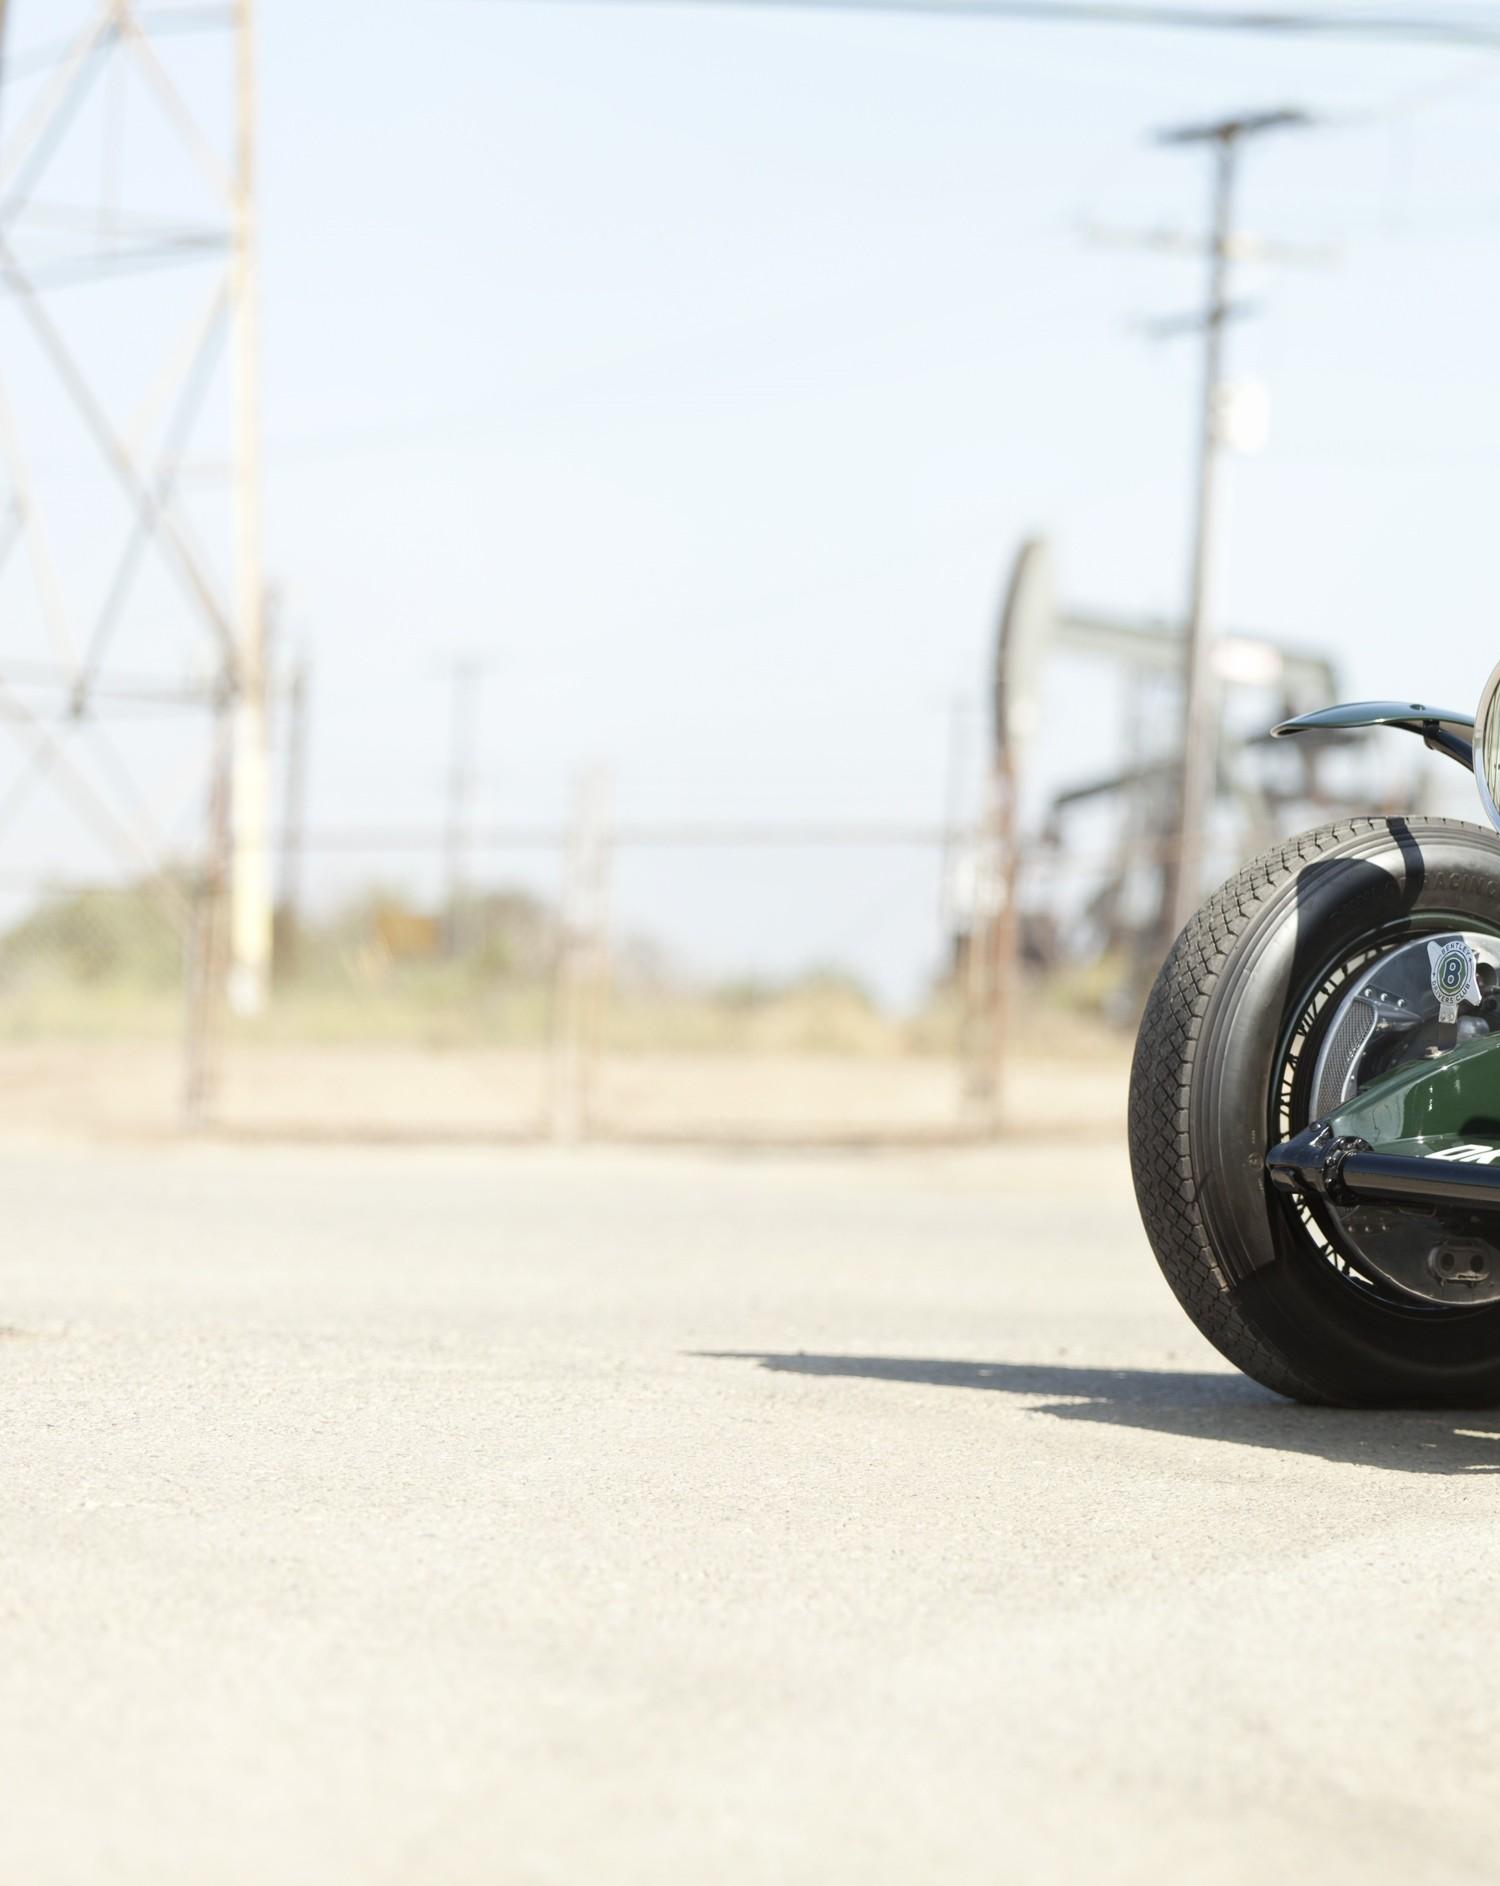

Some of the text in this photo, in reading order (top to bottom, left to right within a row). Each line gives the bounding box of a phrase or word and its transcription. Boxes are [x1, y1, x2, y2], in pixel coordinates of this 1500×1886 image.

[1441, 942, 1471, 956] BENTLEY
[1441, 957, 1463, 989] B
[1431, 980, 1471, 1004] DRIVERS CLUB
